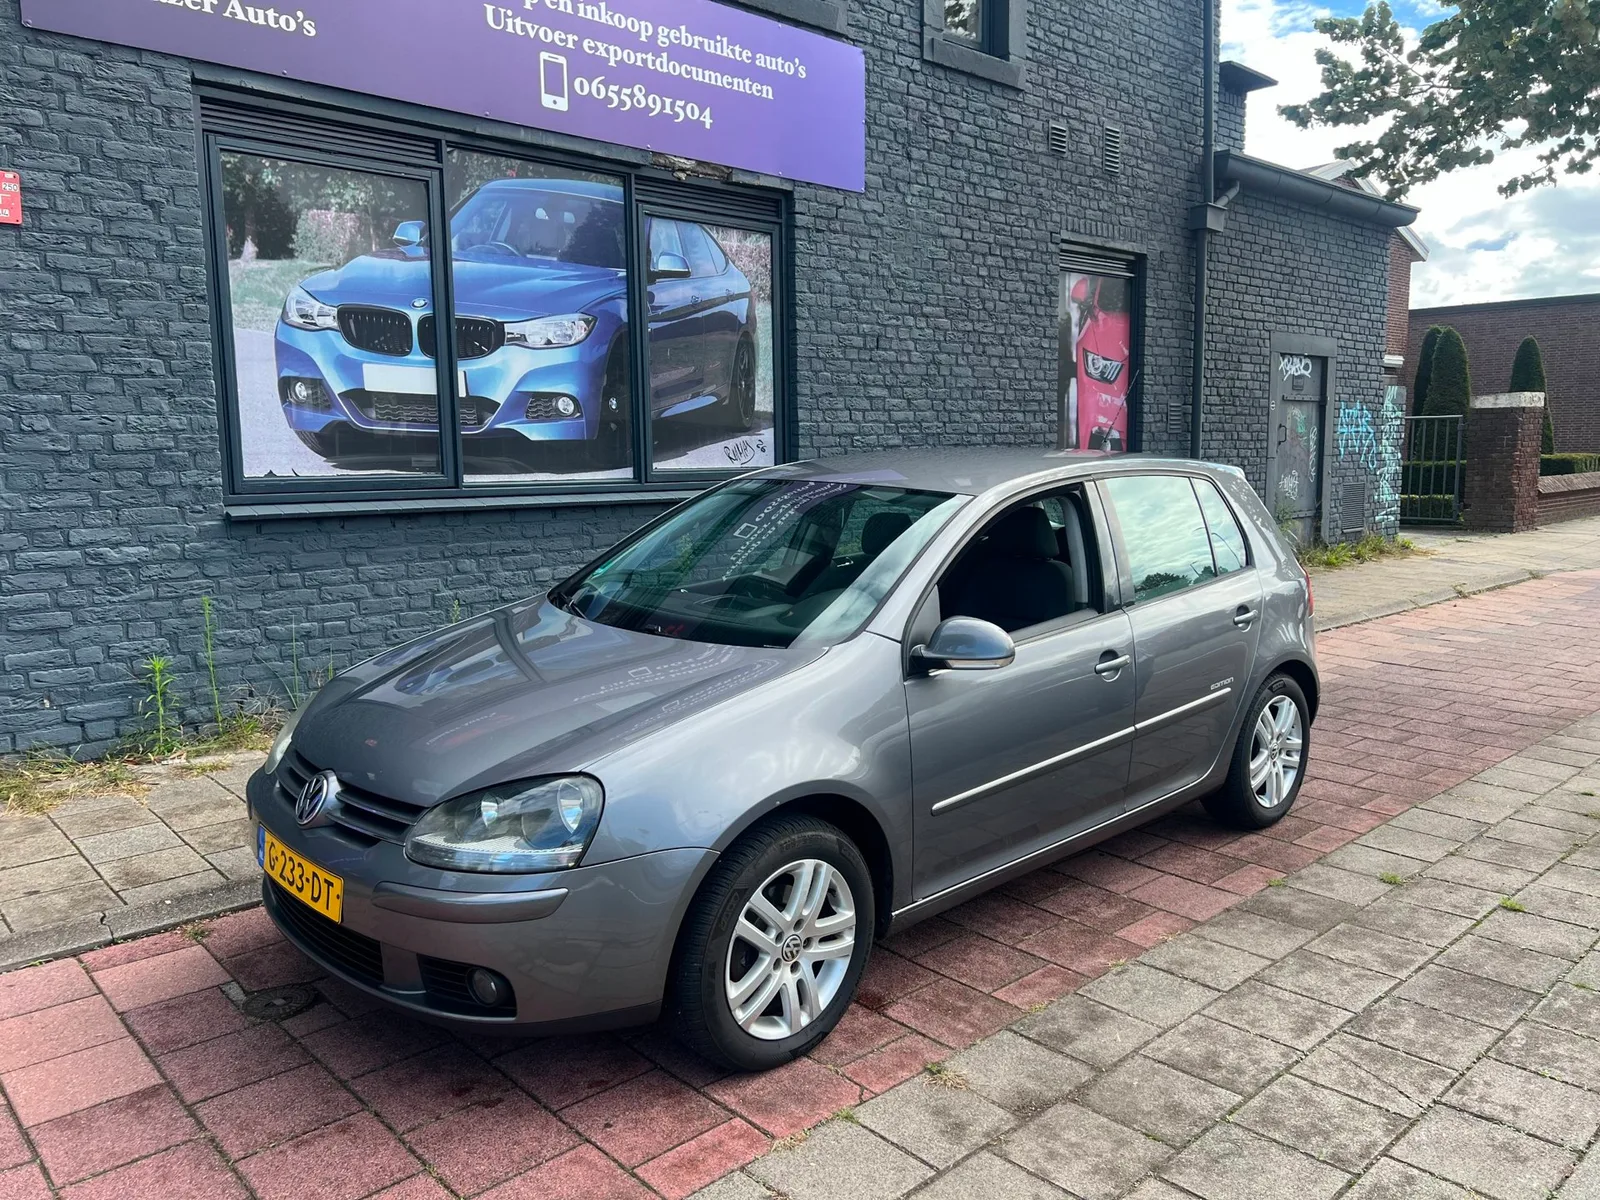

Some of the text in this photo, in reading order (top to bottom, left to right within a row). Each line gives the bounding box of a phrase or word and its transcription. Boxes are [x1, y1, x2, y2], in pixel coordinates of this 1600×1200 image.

[153, 0, 218, 14] er
[483, 3, 775, 100] Uitvoer exportdocumenten
[544, 0, 807, 79] en inkoop gebruikte auto's
[573, 75, 713, 129] 0655891504
[2, 182, 19, 192] 250
[268, 841, 334, 911] G-233-DT
